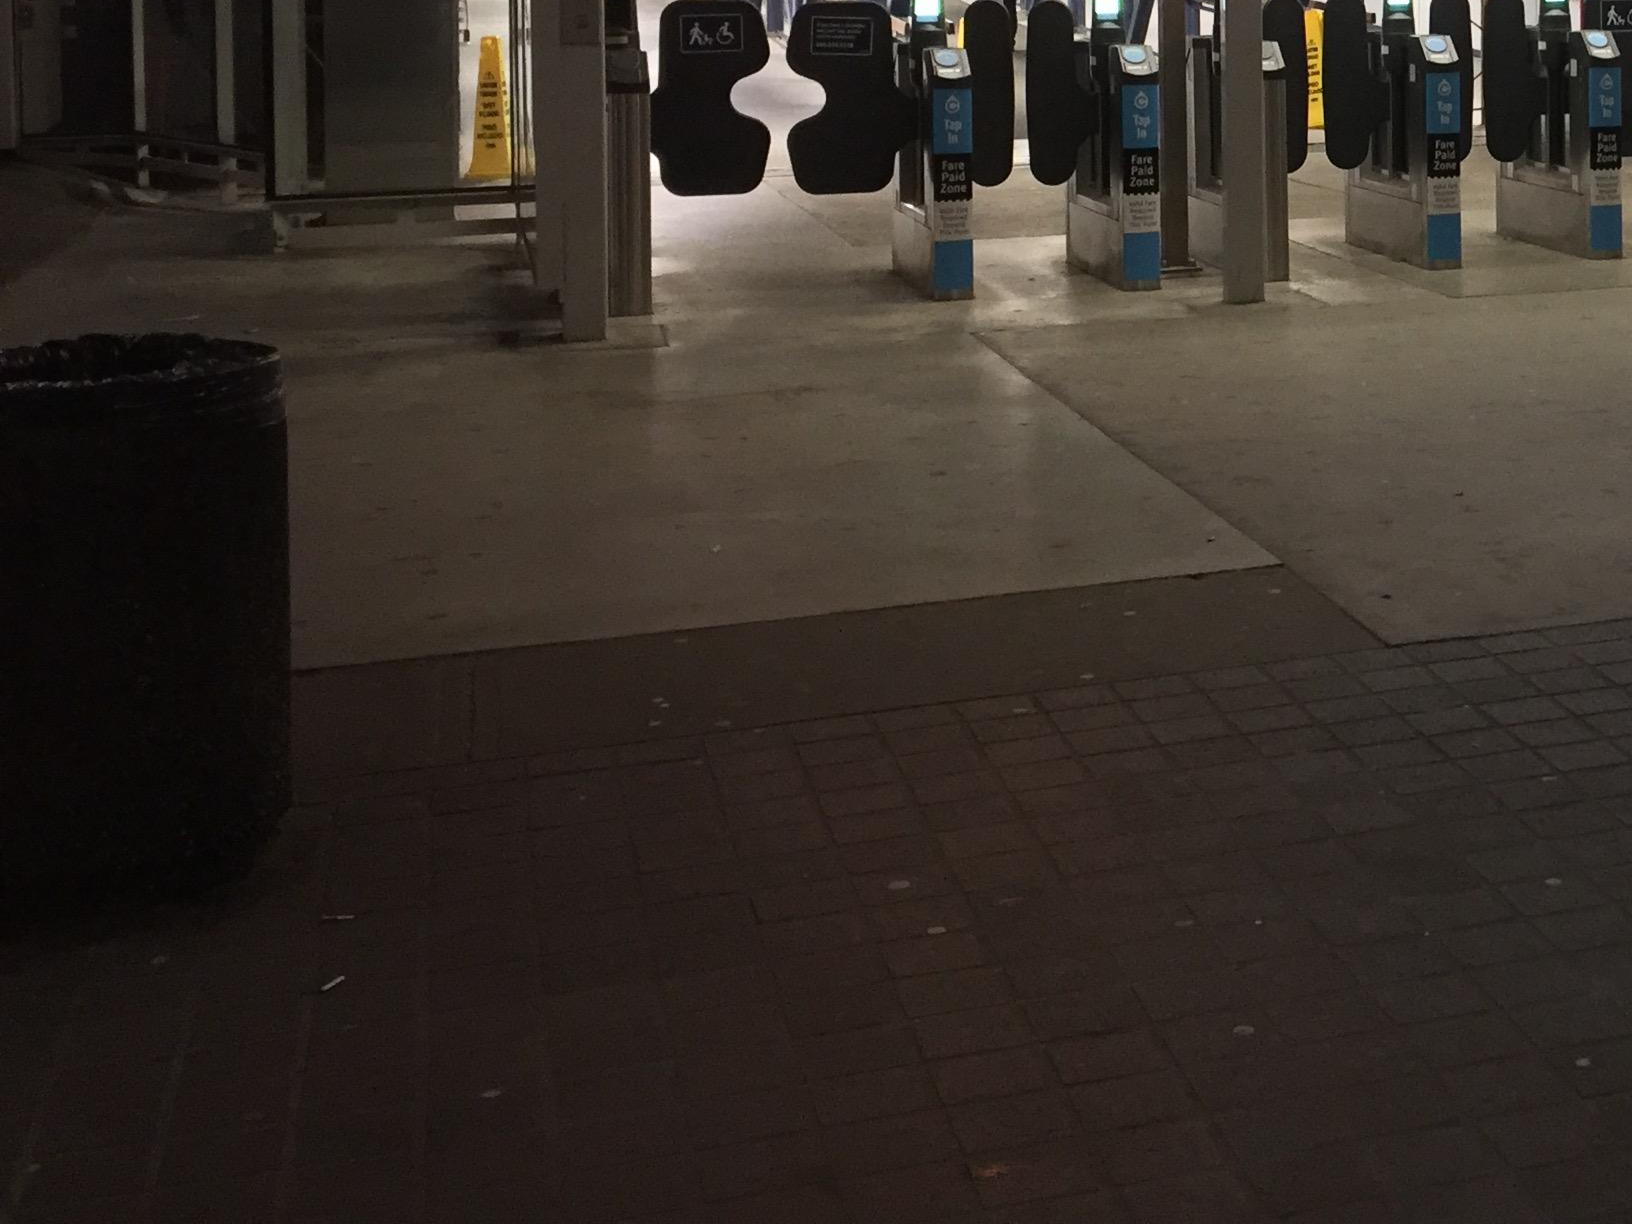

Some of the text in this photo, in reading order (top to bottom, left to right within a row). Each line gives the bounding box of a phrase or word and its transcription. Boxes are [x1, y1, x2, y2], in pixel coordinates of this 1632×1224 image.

[1435, 139, 1455, 149] Fare
[1131, 154, 1153, 165] Fare
[1434, 150, 1456, 160] Paid
[941, 160, 965, 171] Fare
[1130, 165, 1154, 176] Paid
[1433, 160, 1457, 171] Zone
[941, 171, 966, 183] Paid
[1129, 177, 1155, 187] Zone
[939, 183, 968, 194] Zone
